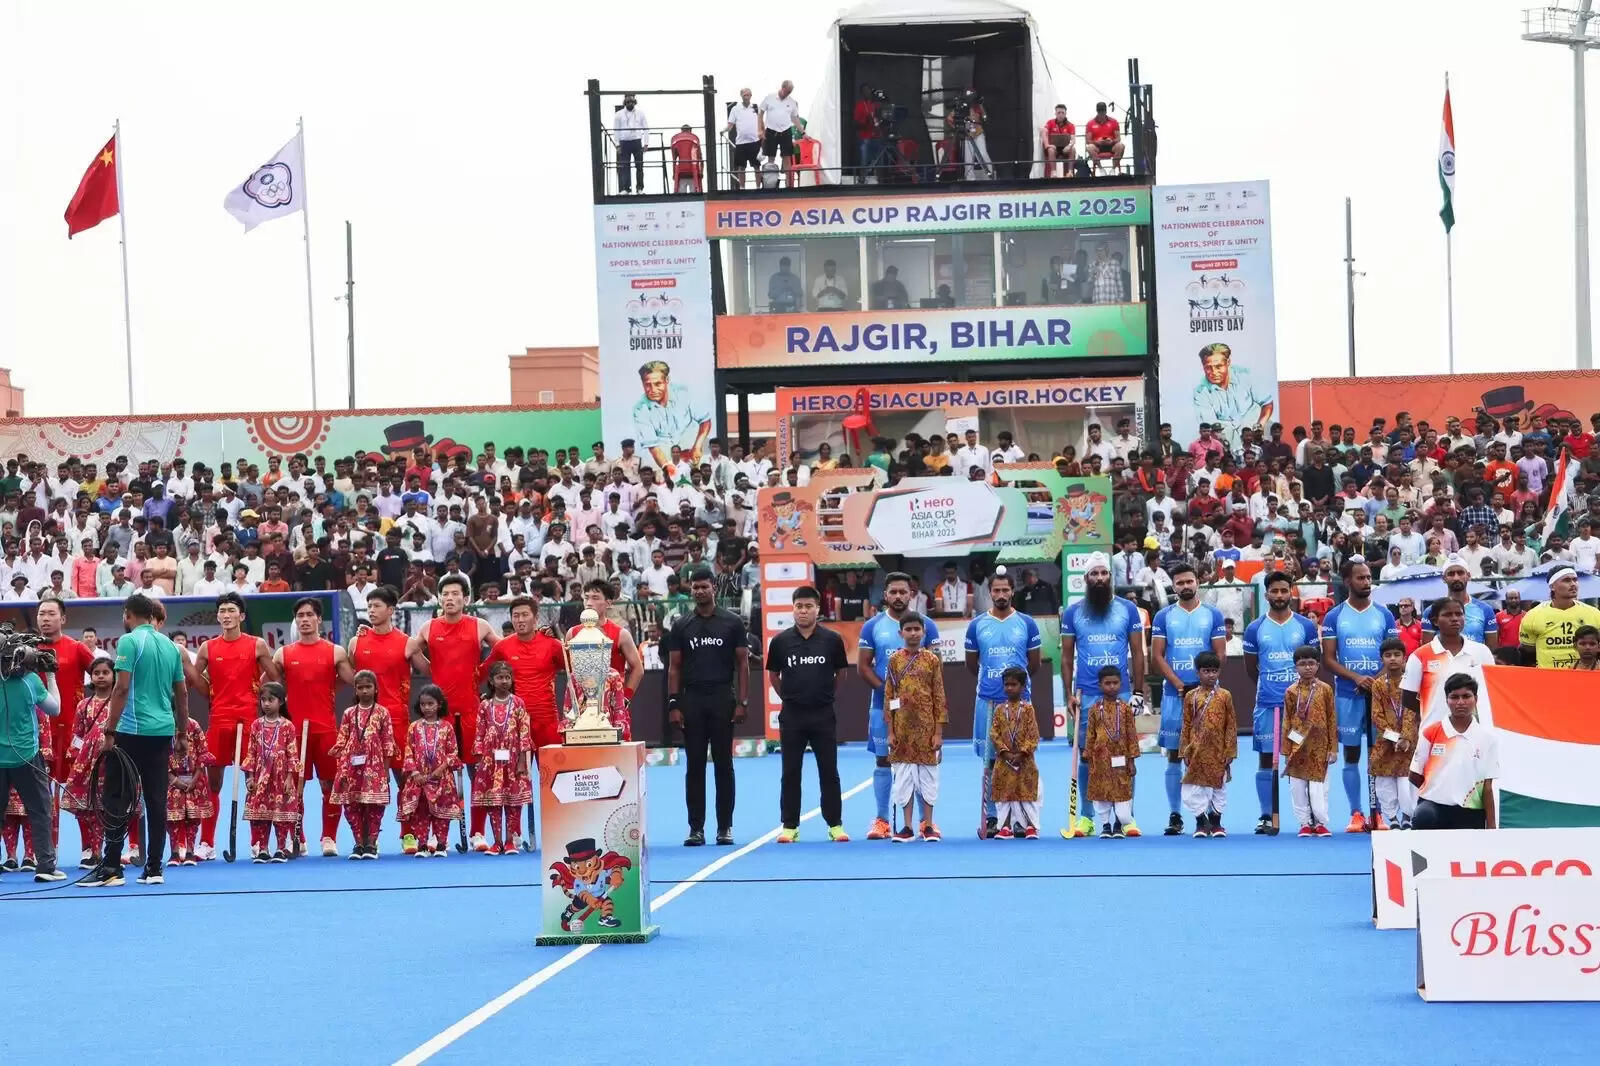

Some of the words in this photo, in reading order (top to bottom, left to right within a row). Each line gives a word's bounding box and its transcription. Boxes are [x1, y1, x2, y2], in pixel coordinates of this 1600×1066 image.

[717, 211, 782, 229] HERO
[789, 208, 845, 226] ASIA
[852, 207, 899, 225] CUP
[906, 203, 991, 223] RAJGIR
[999, 200, 1071, 219] BIHAR
[1078, 197, 1136, 216] 2025
[1161, 222, 1211, 230] NATIONWIDE
[1212, 219, 1265, 228] CELEBRATION
[602, 240, 651, 249] NATIONWIDE
[652, 238, 703, 247] CELEBRATION
[1169, 241, 1201, 249] SPORTS,
[1202, 239, 1226, 247] SPIRIT
[642, 258, 665, 266] SPIRIT
[1190, 319, 1224, 333] SPORTS
[1227, 317, 1244, 332] DAY
[786, 324, 939, 355] RAJGIR,
[950, 318, 1072, 349] BIHAR
[629, 337, 663, 351] SPORTS
[666, 335, 683, 349] DAY
[792, 386, 1128, 412] HEROASIACUPRAJGIR.HOCKEY
[924, 497, 954, 509] Hero
[910, 511, 933, 521] ASIA
[934, 509, 956, 519] CUP
[911, 530, 935, 539] BIHAR
[937, 528, 956, 537] 2025
[1561, 621, 1573, 635] 12
[701, 636, 724, 647] Hero
[1087, 633, 1117, 642] ODISHA
[1174, 637, 1204, 646] ODISHA
[1345, 637, 1376, 646] ODISHA
[987, 646, 1017, 656] ODISHA
[800, 655, 826, 665] Hero
[1087, 650, 1120, 667] india
[1171, 655, 1196, 671] ind
[1344, 654, 1380, 671] india
[1266, 666, 1301, 683] india
[1450, 903, 1600, 974] Bliss
